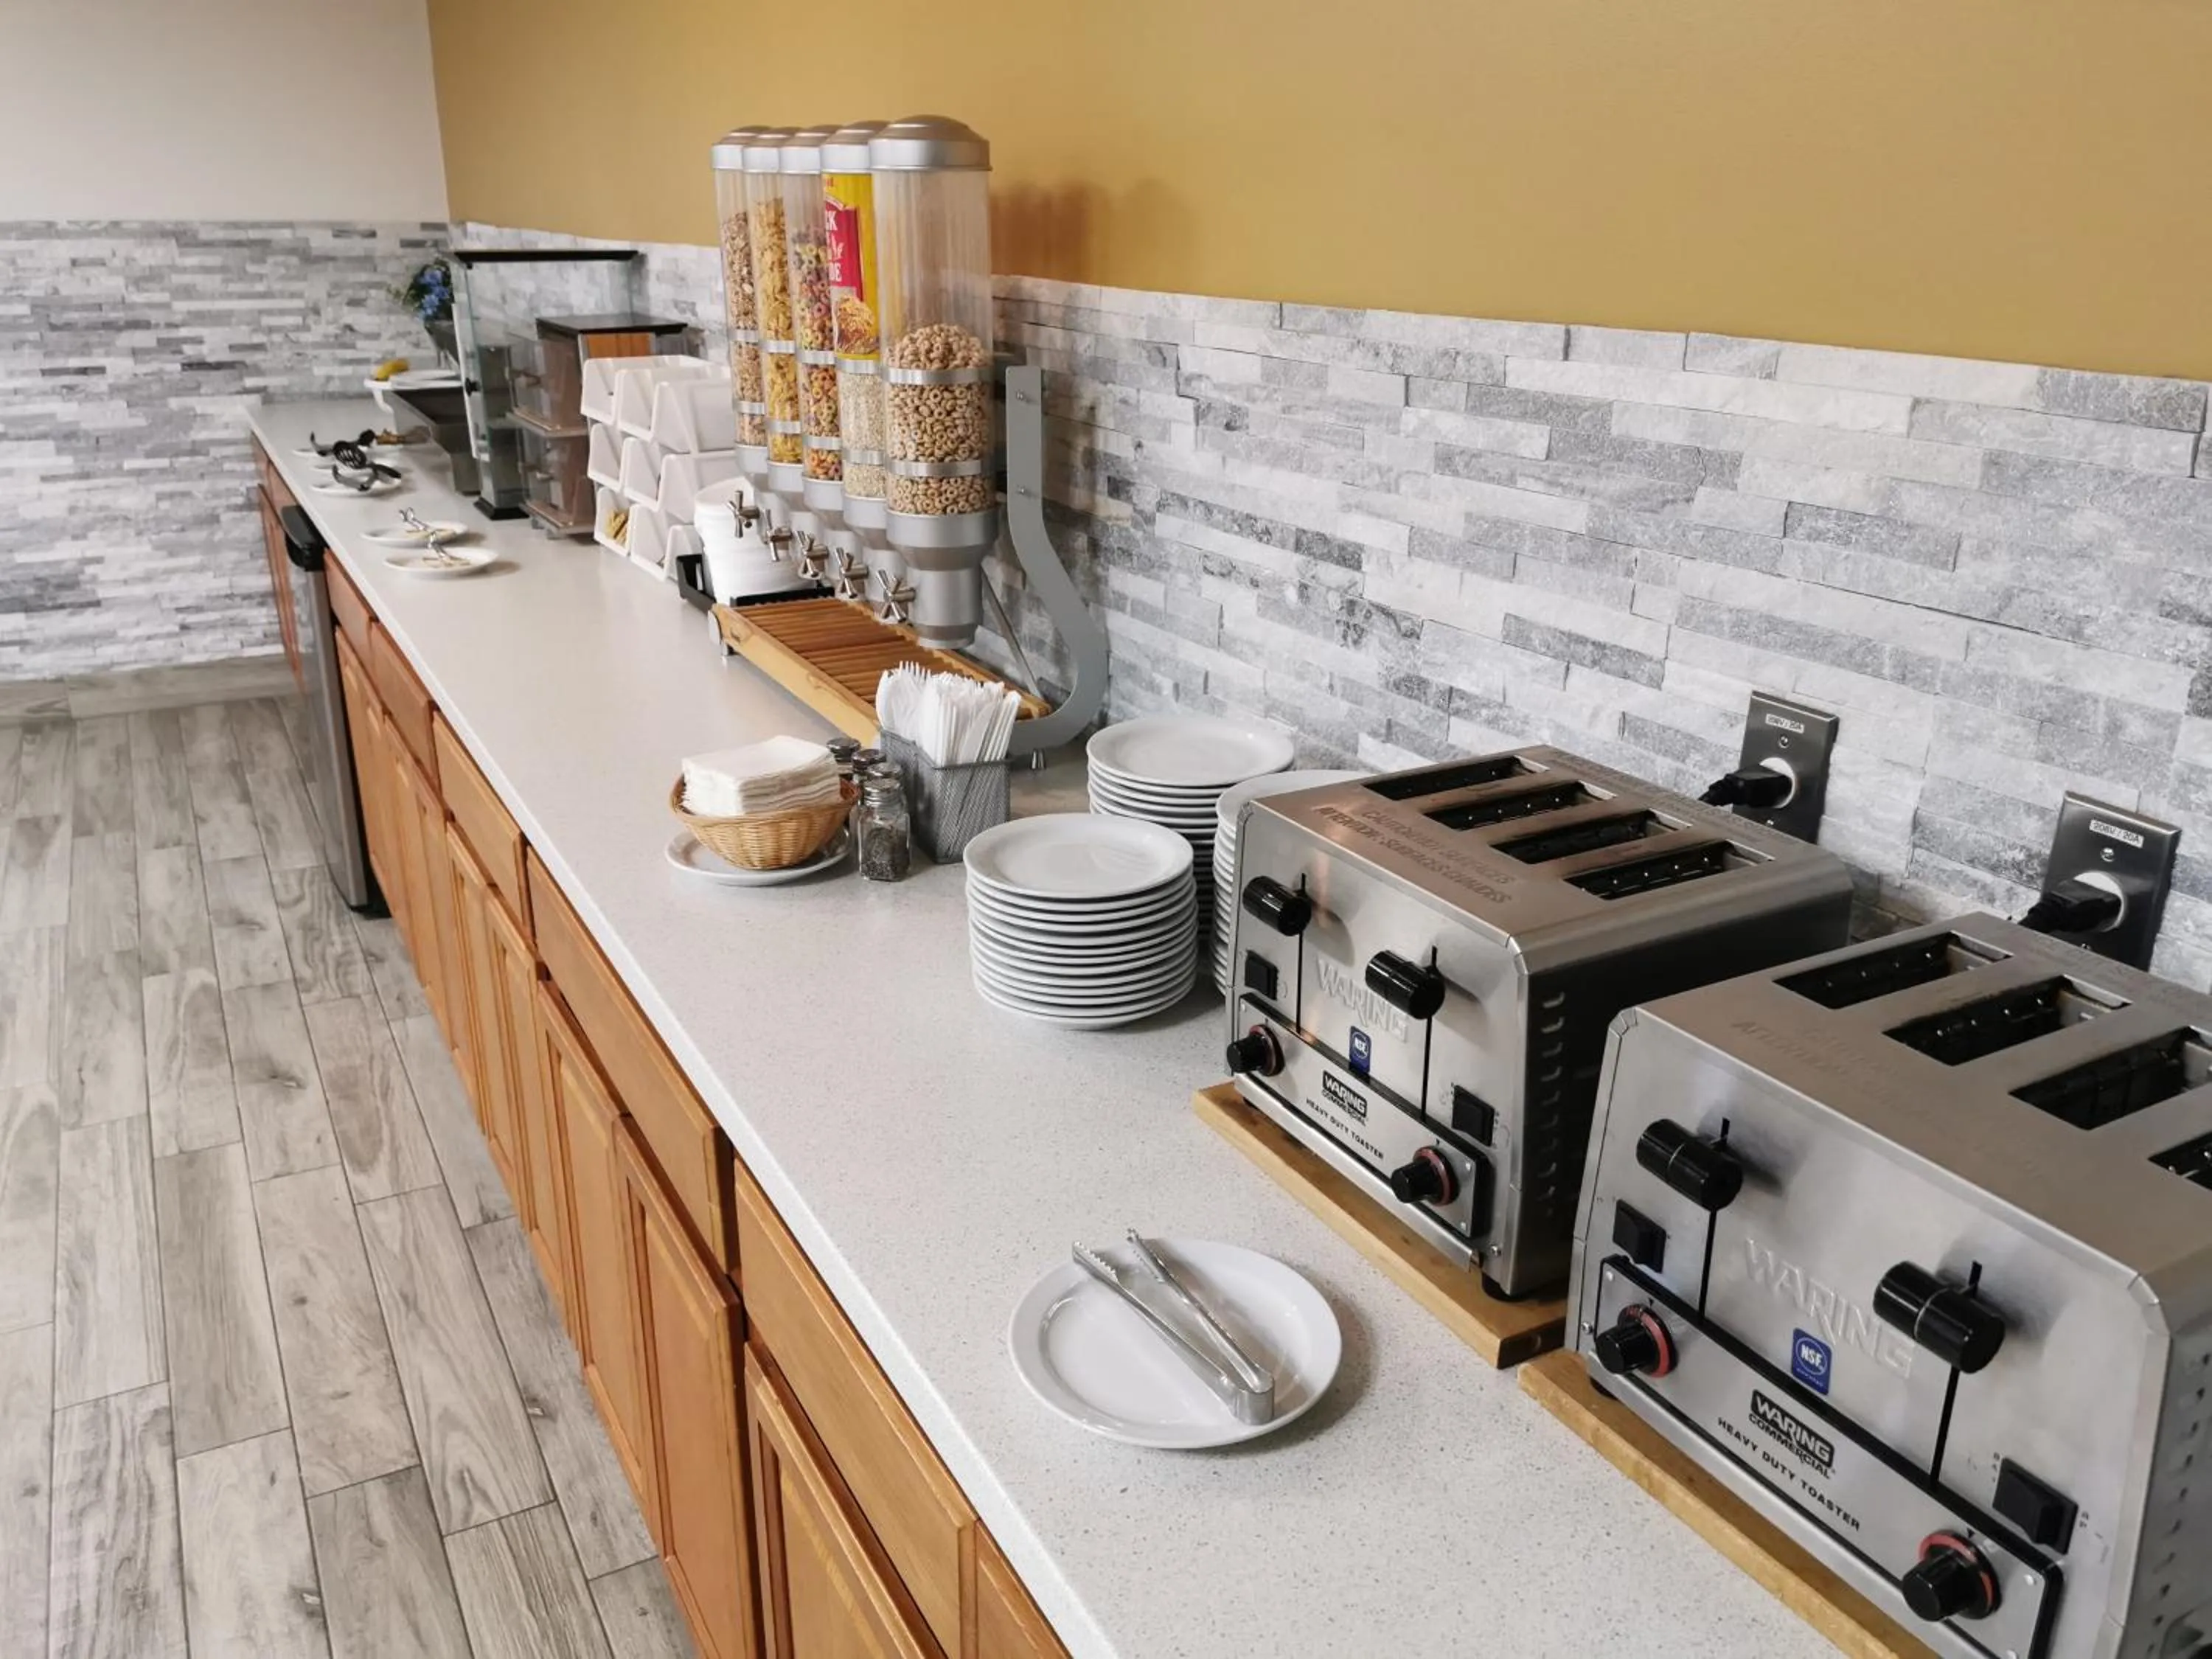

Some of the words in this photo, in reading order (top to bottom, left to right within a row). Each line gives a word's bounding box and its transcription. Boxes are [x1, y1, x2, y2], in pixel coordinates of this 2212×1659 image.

[1316, 958, 1408, 1043] WARING
[1306, 1097, 1329, 1119] HEAVY
[1329, 1115, 1349, 1134] DUTY
[1351, 1130, 1384, 1160] TOASTER
[1321, 1088, 1366, 1127] COMMERCIAL
[1324, 1074, 1366, 1115] WARING
[1745, 1237, 1916, 1378] WARING
[1801, 1343, 1822, 1368] NSF
[1748, 1412, 1831, 1480] COMMERCIAL
[1755, 1394, 1832, 1465] WARING
[1717, 1416, 1758, 1452] HEAVY
[1761, 1450, 1795, 1481] DUTY
[1801, 1478, 1860, 1531] TOASTER
